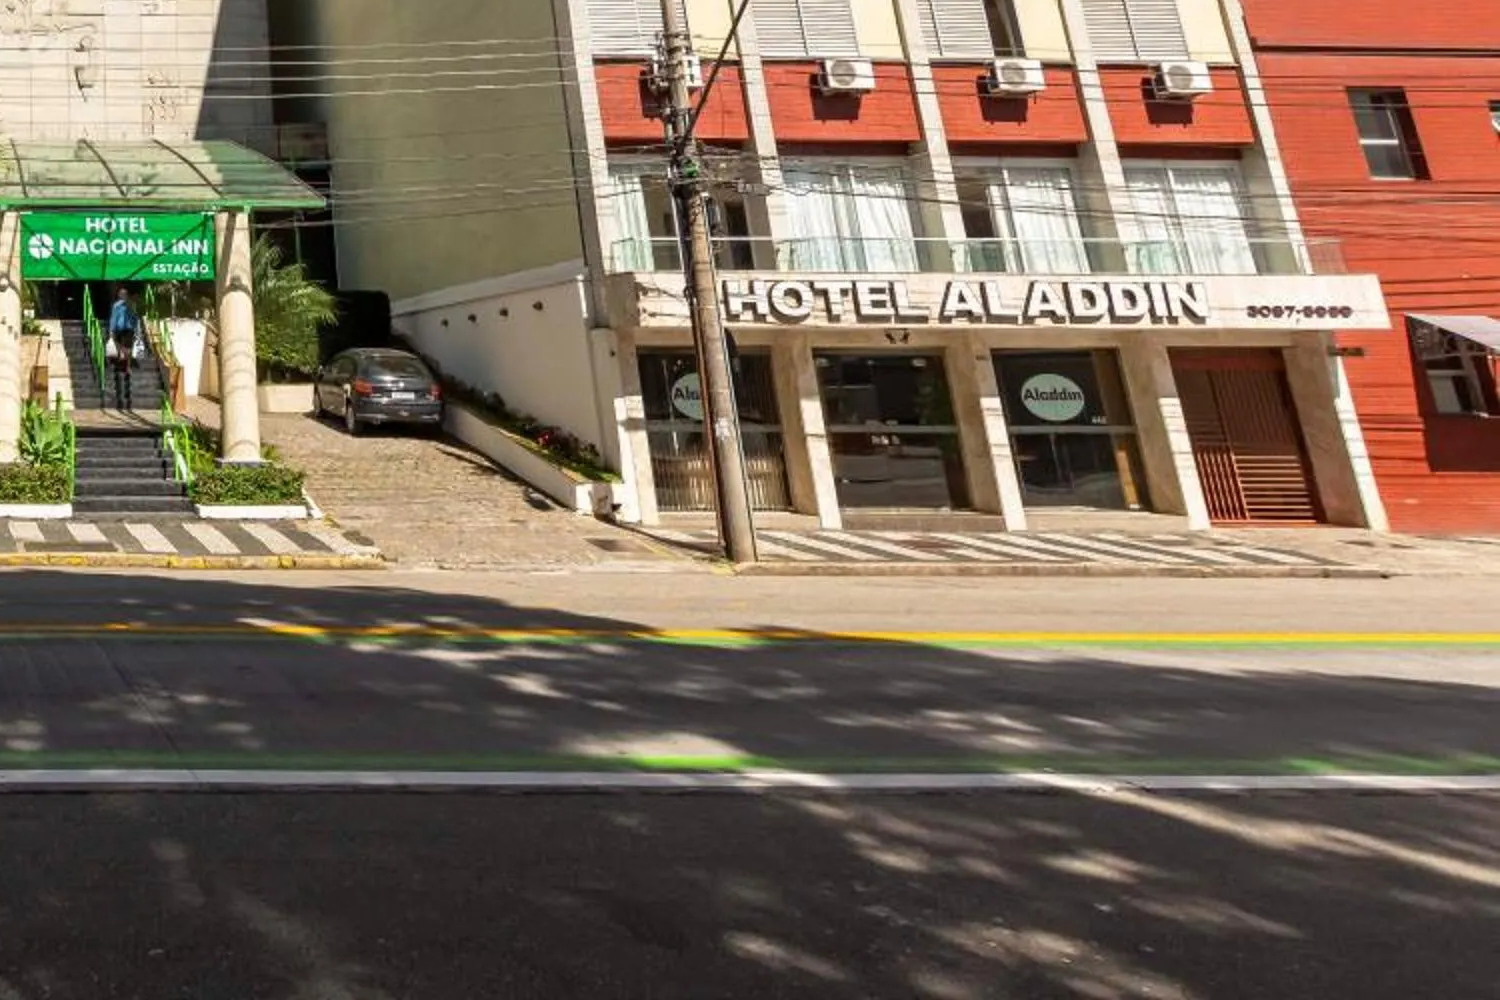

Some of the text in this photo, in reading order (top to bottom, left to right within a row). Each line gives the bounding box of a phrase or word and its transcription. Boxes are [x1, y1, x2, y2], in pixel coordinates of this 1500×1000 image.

[85, 217, 148, 233] HOTEL
[59, 238, 209, 255] NACIONAL INN
[153, 262, 209, 276] ESTAÇÃO
[722, 280, 1211, 324] HOTEL ALADDIN
[673, 386, 701, 400] Ala
[1024, 386, 1082, 401] Aladdin
